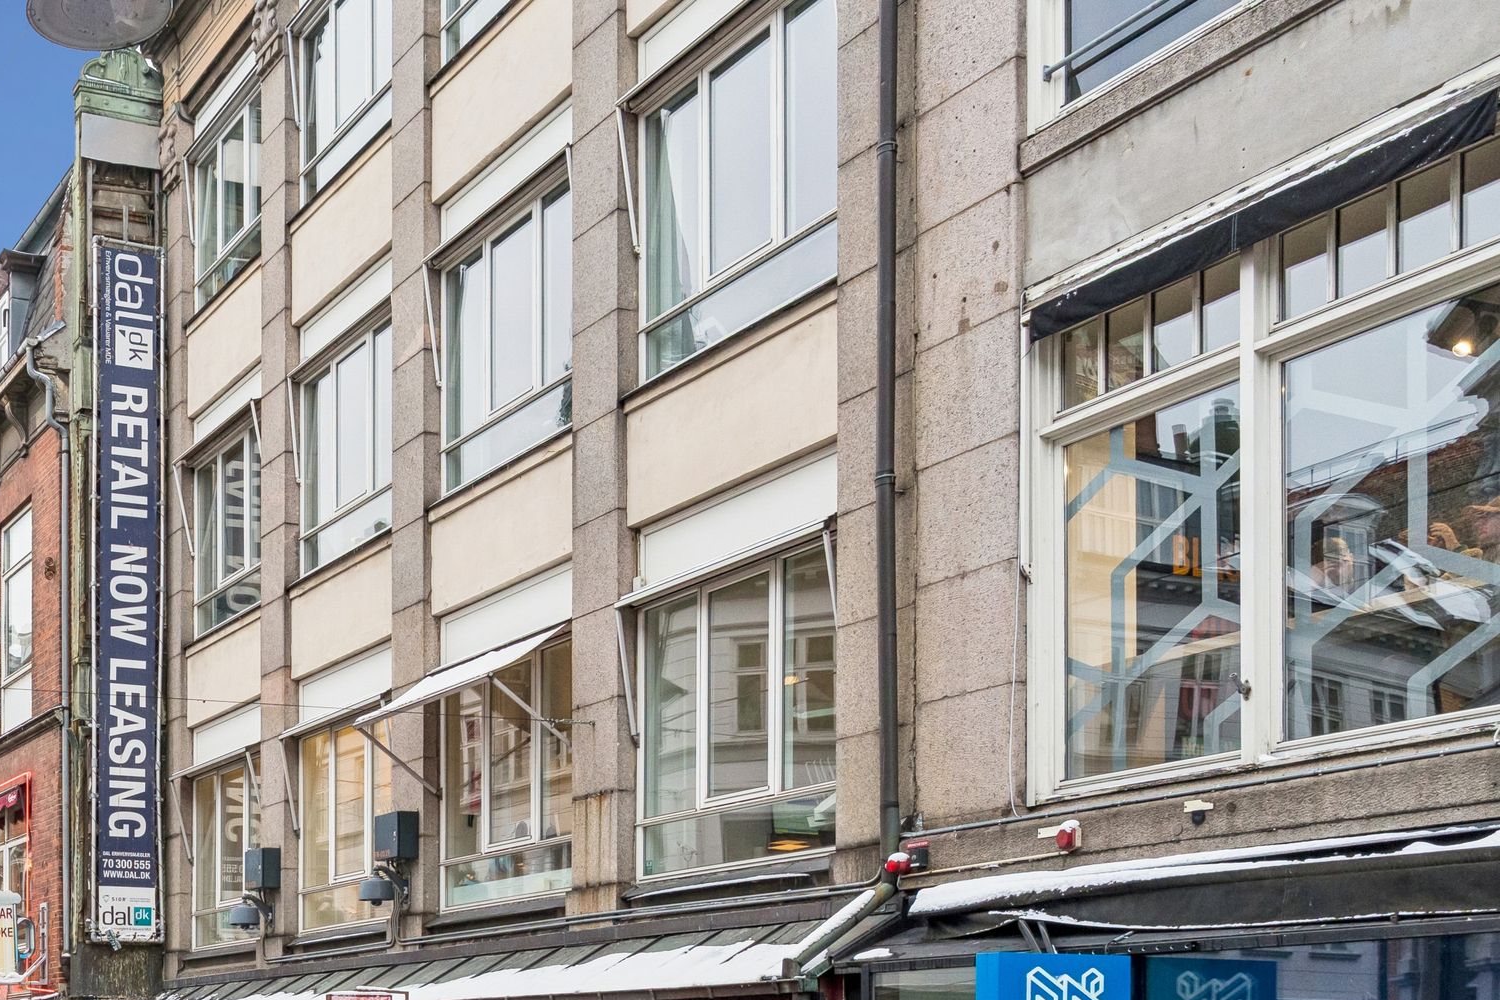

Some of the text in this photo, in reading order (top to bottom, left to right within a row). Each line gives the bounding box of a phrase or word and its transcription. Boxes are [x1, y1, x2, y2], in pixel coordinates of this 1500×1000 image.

[114, 253, 153, 361] dal dk
[108, 384, 149, 839] RETAIL NOW LEASING
[102, 858, 150, 870] 70 300 555
[102, 870, 150, 880] WWW.DAL.DK
[102, 906, 150, 926] dal dk
